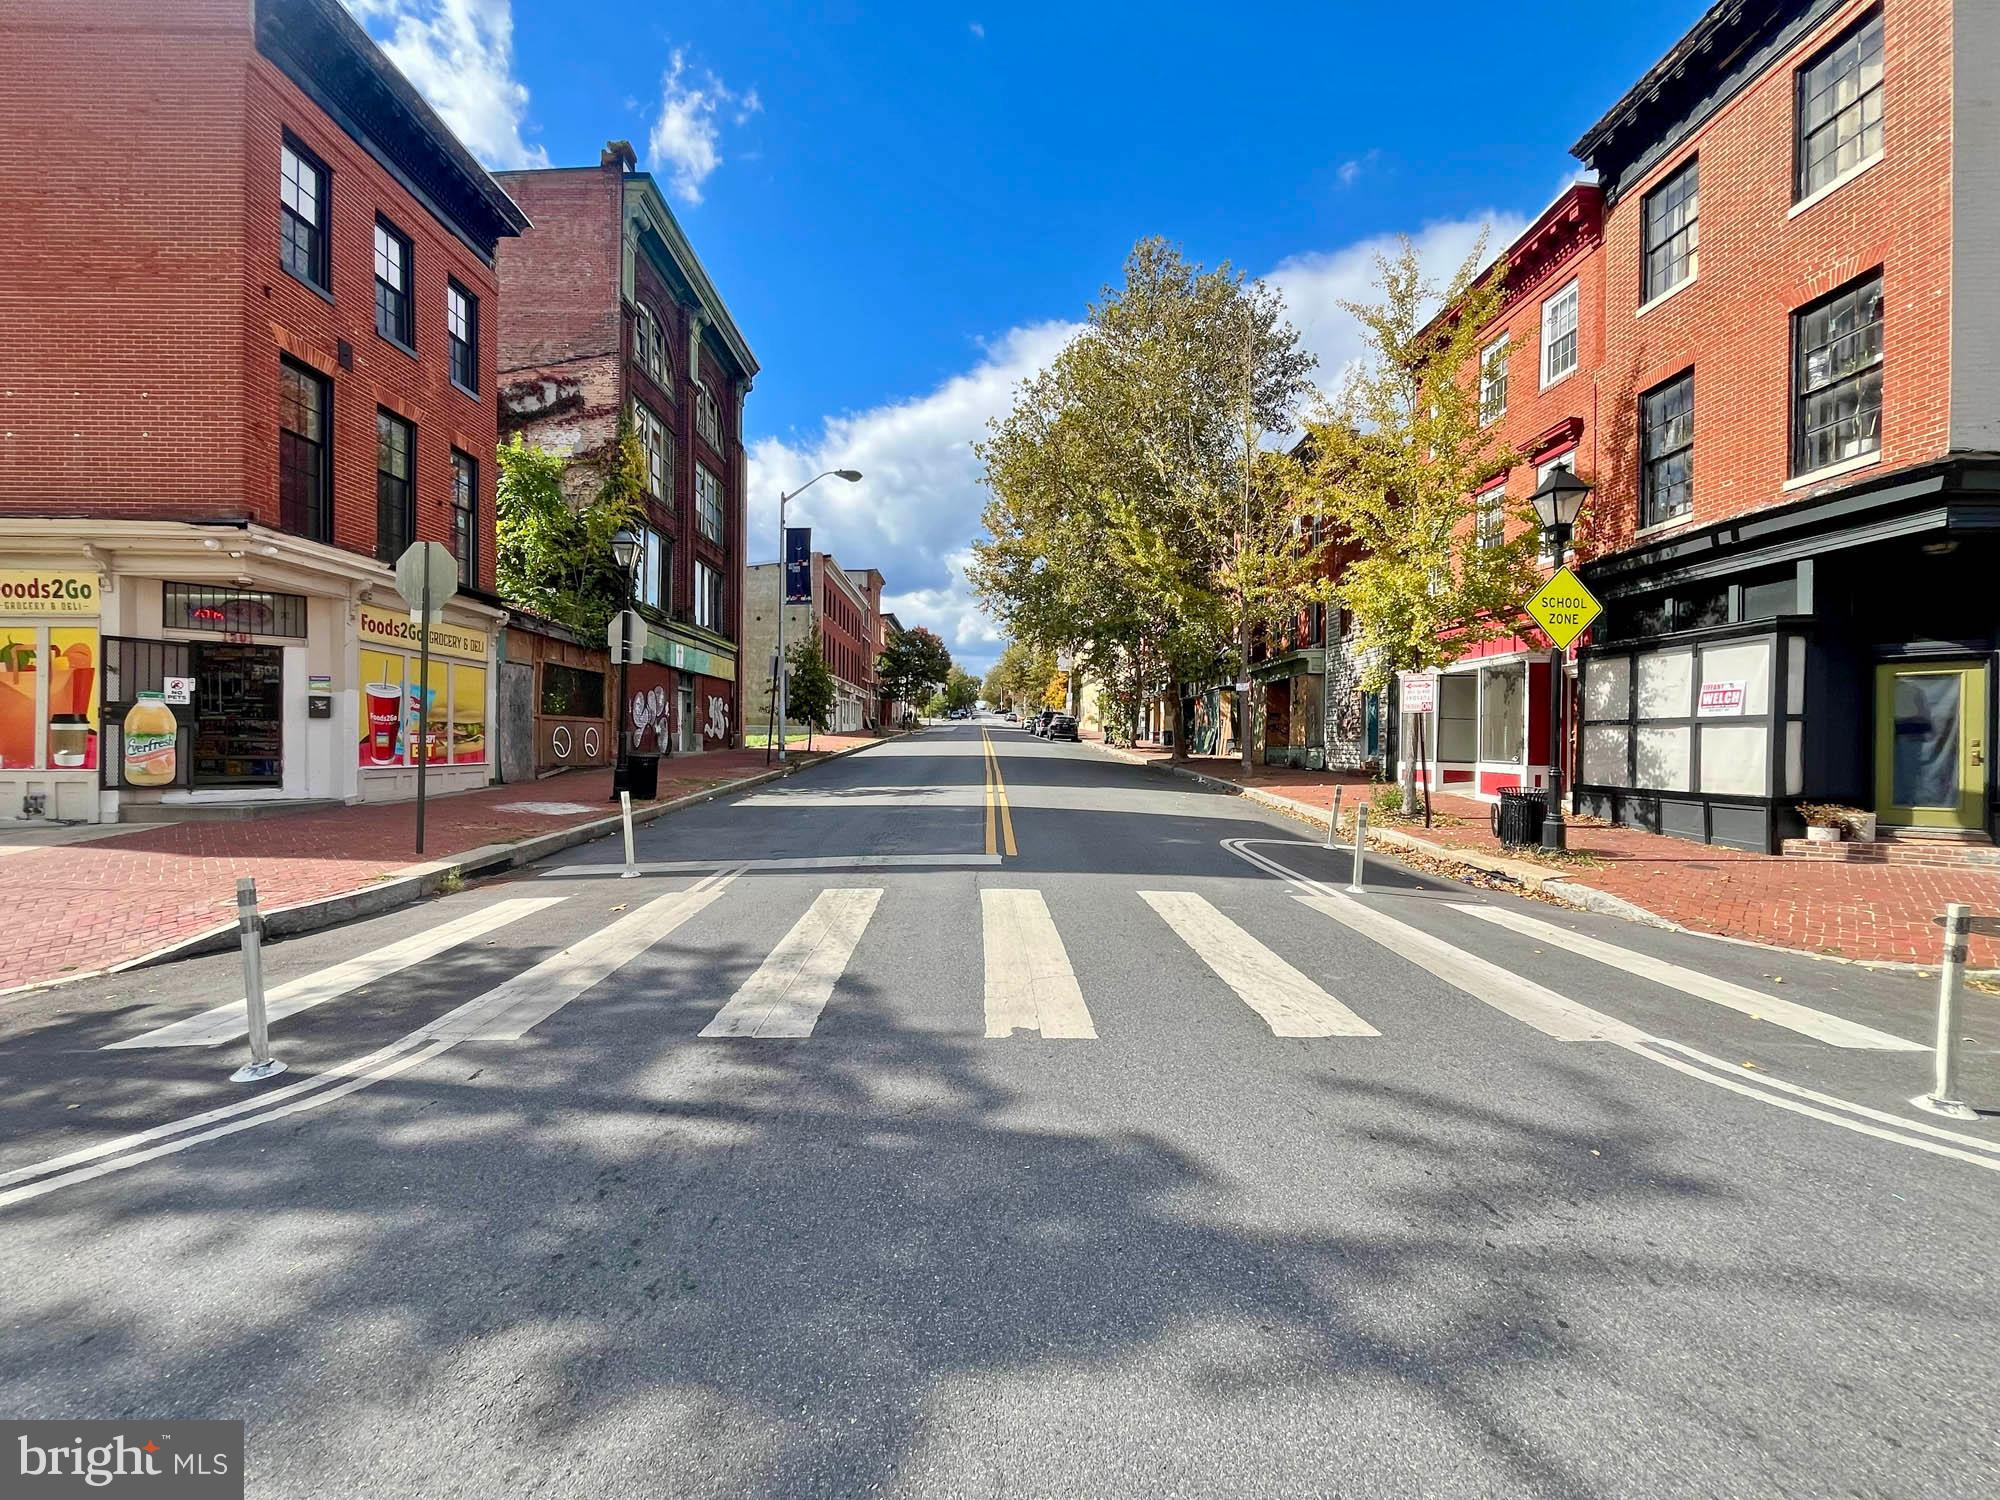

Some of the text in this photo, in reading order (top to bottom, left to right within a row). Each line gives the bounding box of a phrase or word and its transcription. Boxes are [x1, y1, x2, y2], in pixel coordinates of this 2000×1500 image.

[0, 578, 92, 599] oods2Go
[4, 602, 46, 610] GROCERY
[61, 602, 82, 610] DELI
[1541, 597, 1587, 609] SCHOOL
[1549, 613, 1579, 625] ZONE
[429, 631, 462, 649] GROCERY
[463, 637, 469, 650] &
[470, 639, 484, 653] DELI
[1703, 691, 1740, 705] WELCH
[127, 736, 174, 756] Everfresh
[411, 744, 434, 758] ET
